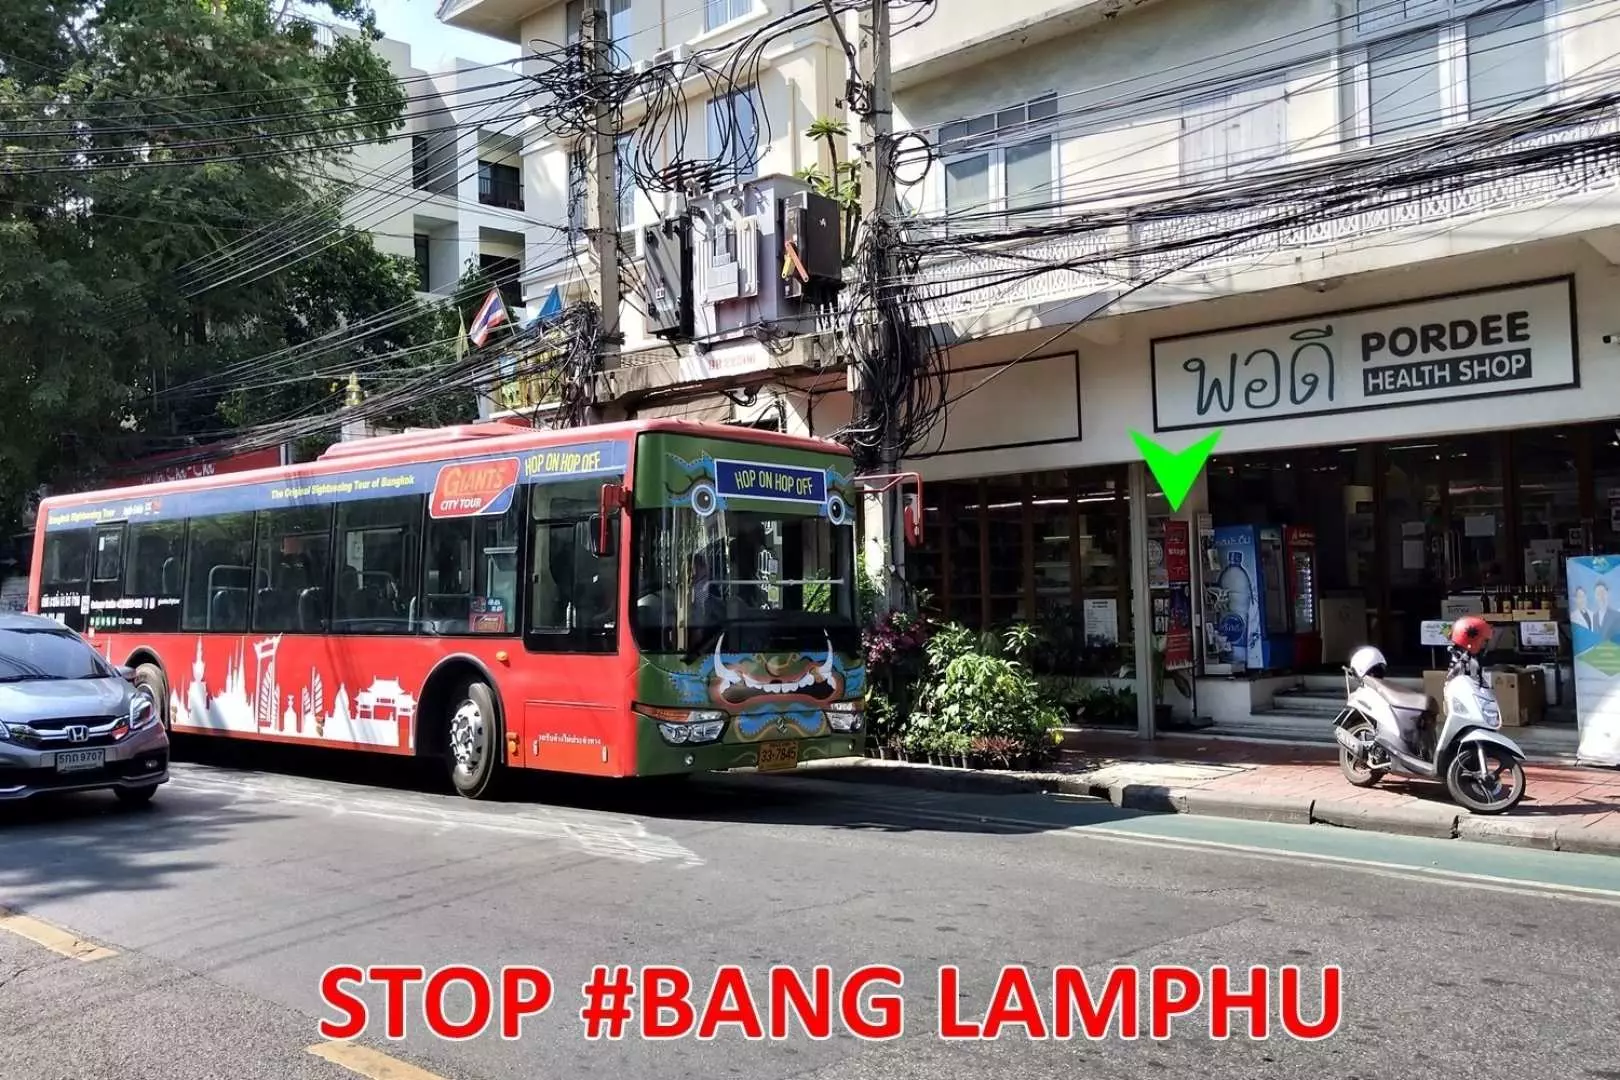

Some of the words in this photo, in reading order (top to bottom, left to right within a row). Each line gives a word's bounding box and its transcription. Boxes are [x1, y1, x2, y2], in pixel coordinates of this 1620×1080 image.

[1361, 310, 1531, 362] PORDEE
[1183, 324, 1334, 416] พอดี
[1367, 361, 1451, 393] HEALTH
[1458, 353, 1527, 382] SHOP
[524, 456, 544, 476] HOP
[545, 454, 559, 473] ON
[560, 453, 580, 473] HOP
[581, 450, 601, 472] OFF
[354, 479, 371, 490] Tour
[371, 477, 381, 488] of
[443, 466, 505, 497] GIANTS
[734, 469, 756, 490] HOP
[758, 470, 773, 489] ON
[774, 473, 795, 493] HOP
[796, 476, 813, 495] OFF
[440, 499, 459, 512] CITY
[460, 497, 482, 509] TOUR
[80, 751, 102, 761] 9707
